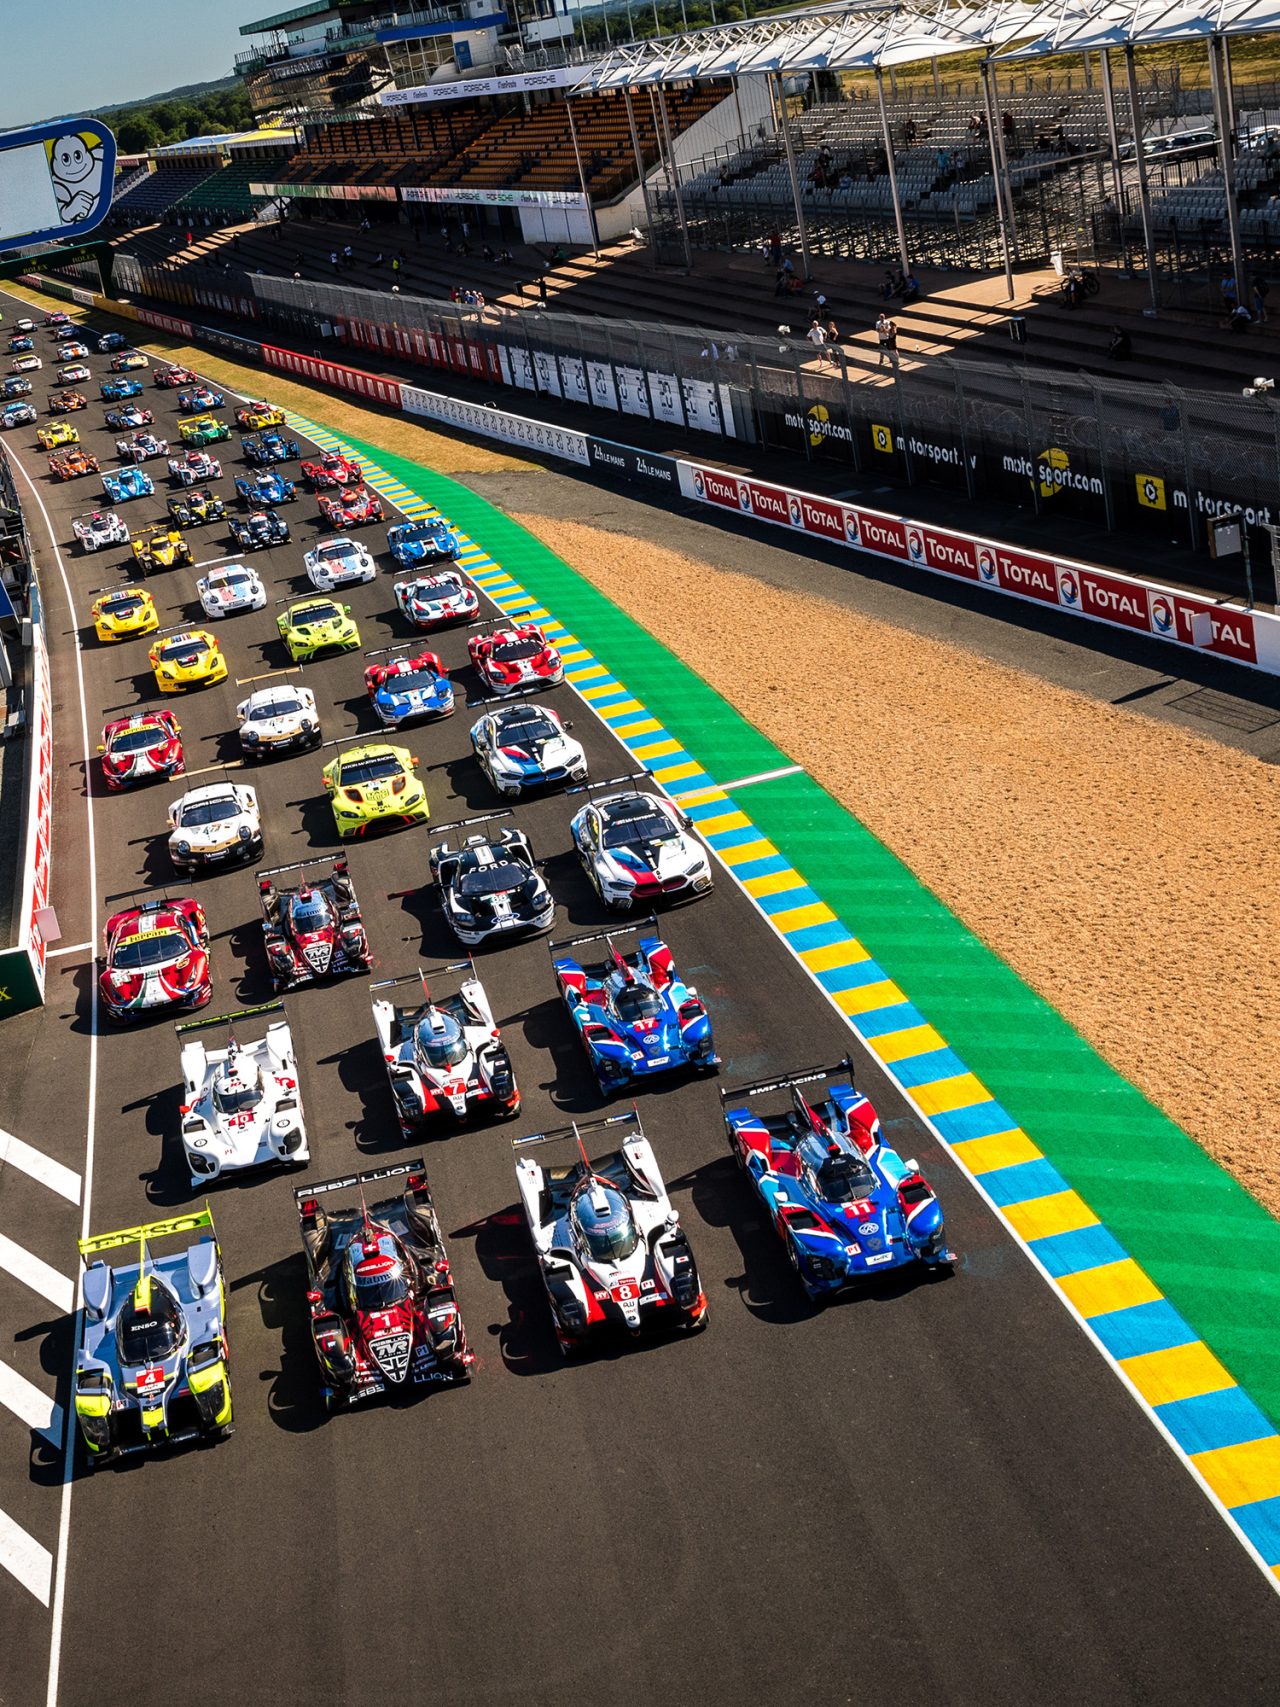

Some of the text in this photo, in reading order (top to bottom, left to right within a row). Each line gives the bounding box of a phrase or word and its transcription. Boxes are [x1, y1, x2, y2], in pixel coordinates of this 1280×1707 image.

[464, 82, 490, 93] PORSCHE
[524, 75, 556, 86] PORSCHE
[705, 476, 738, 501] TOTAL
[752, 490, 787, 516] TOTAL
[803, 504, 843, 532] TOTAL
[862, 520, 905, 549] TOTAL
[926, 537, 975, 569] TOTAL
[999, 557, 1054, 592] TOTAL
[1083, 580, 1145, 619] TOTAL
[1179, 607, 1251, 649] TTAL
[499, 638, 528, 649] FORD
[394, 669, 419, 679] FORD
[469, 859, 509, 874] FORD
[637, 1019, 654, 1030] 17
[450, 1083, 459, 1095] 7
[234, 1115, 250, 1125] 10
[849, 1202, 871, 1216] 11
[847, 1246, 858, 1254] P1
[619, 1285, 632, 1300] 8
[130, 1321, 158, 1332] ENSO
[381, 1315, 390, 1327] 1
[376, 1341, 408, 1356] TVR
[145, 1373, 156, 1384] 4
